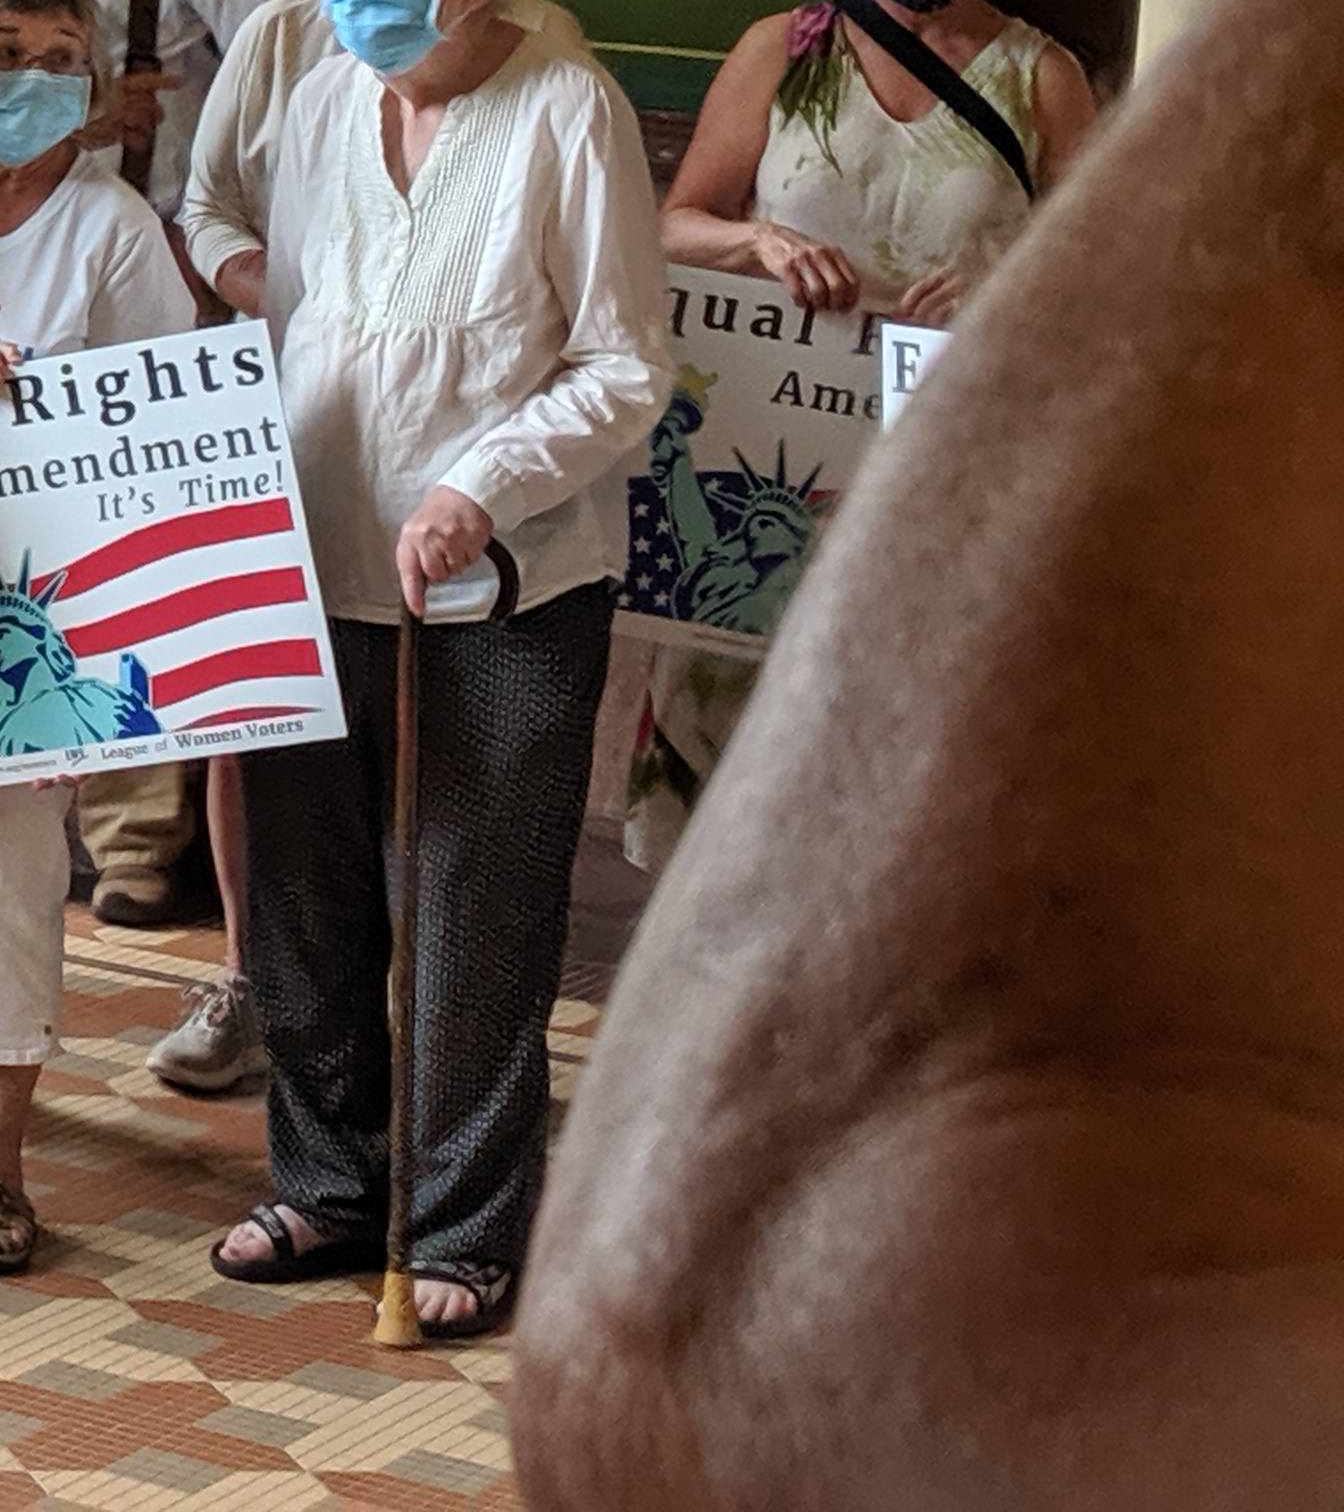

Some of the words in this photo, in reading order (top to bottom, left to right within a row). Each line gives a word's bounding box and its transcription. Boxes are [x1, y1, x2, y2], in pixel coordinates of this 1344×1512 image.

[9, 344, 267, 427] Rights
[97, 491, 156, 523] It's
[178, 460, 285, 509] Time!
[100, 743, 149, 761] League
[174, 728, 243, 750] Women
[243, 718, 305, 739] Voters
